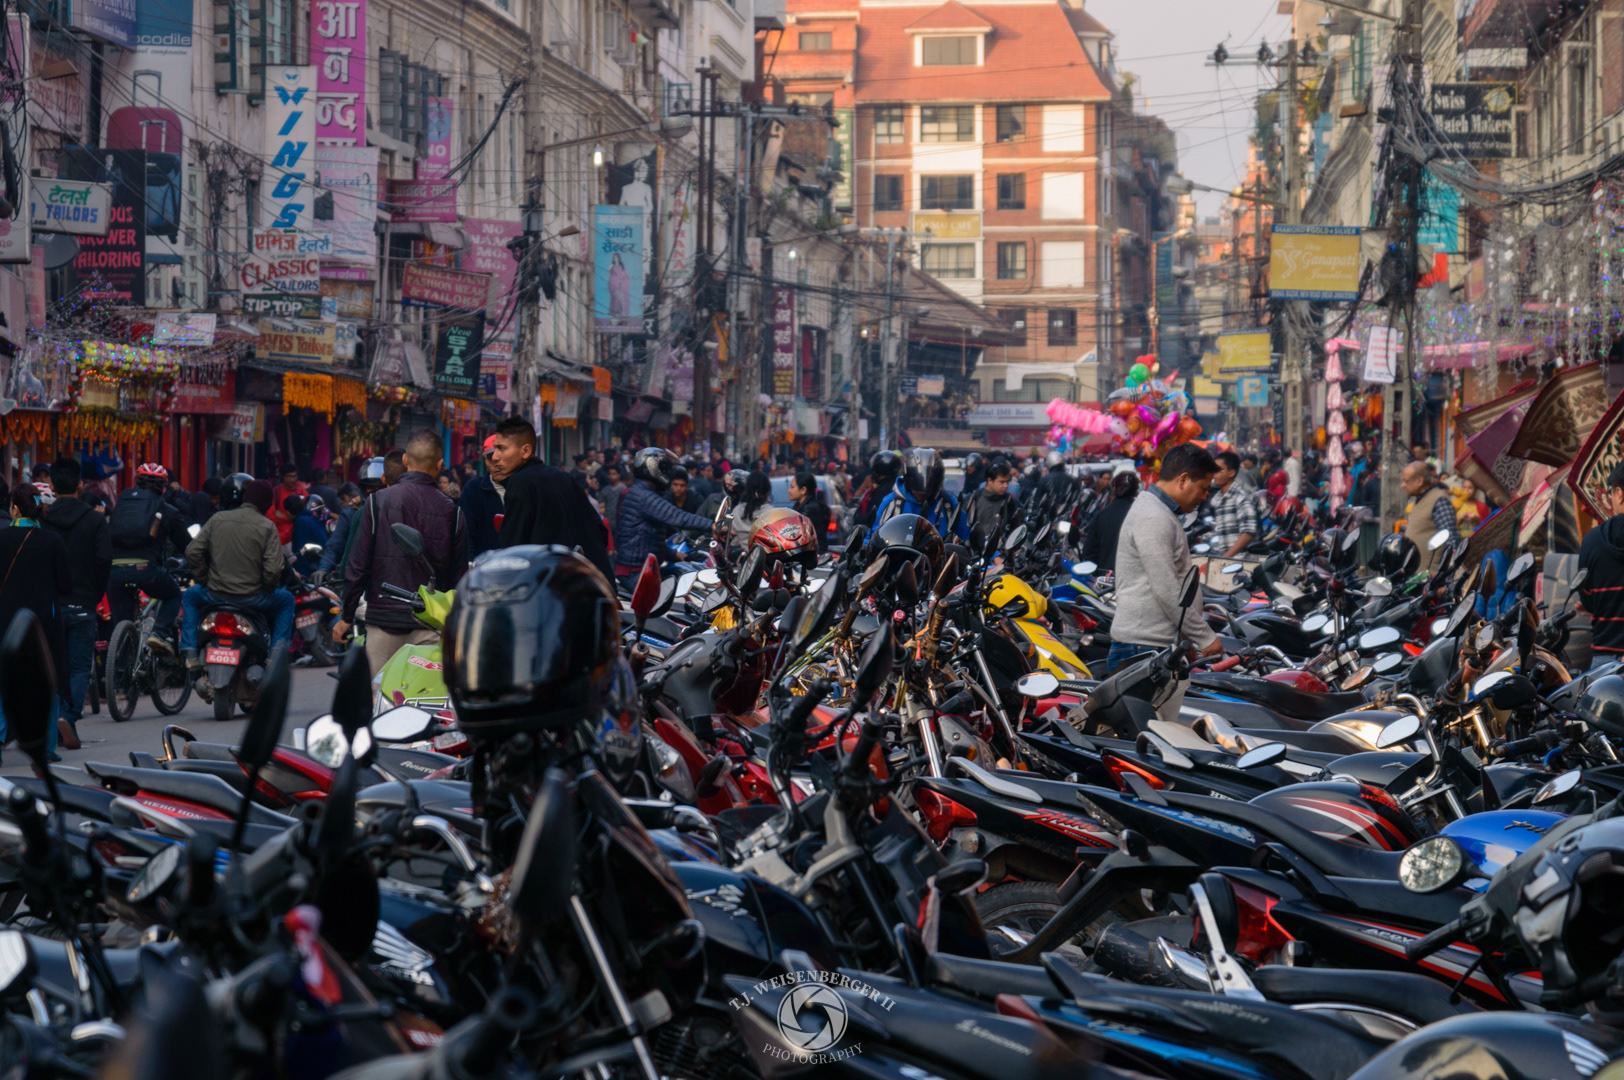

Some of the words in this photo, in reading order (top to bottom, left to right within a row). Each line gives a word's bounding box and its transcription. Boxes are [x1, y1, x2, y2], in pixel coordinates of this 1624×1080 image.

[1434, 90, 1466, 109] Swiss
[1434, 114, 1469, 133] Watch
[270, 86, 310, 228] WINGS
[49, 185, 92, 205] टेलर्स
[46, 204, 98, 223] TAILORS
[73, 252, 142, 269] AILORING
[1301, 252, 1357, 270] Ganapati
[241, 259, 318, 288] CLASSIC
[274, 280, 319, 292] TAILORS
[245, 298, 271, 312] TIP
[272, 300, 302, 317] TOP
[446, 326, 472, 337] New
[444, 335, 467, 375] STAR
[435, 375, 474, 387] TAILORS
[1243, 378, 1262, 404] P
[144, 800, 176, 812] HERO
[1360, 793, 1400, 814] HONDA
